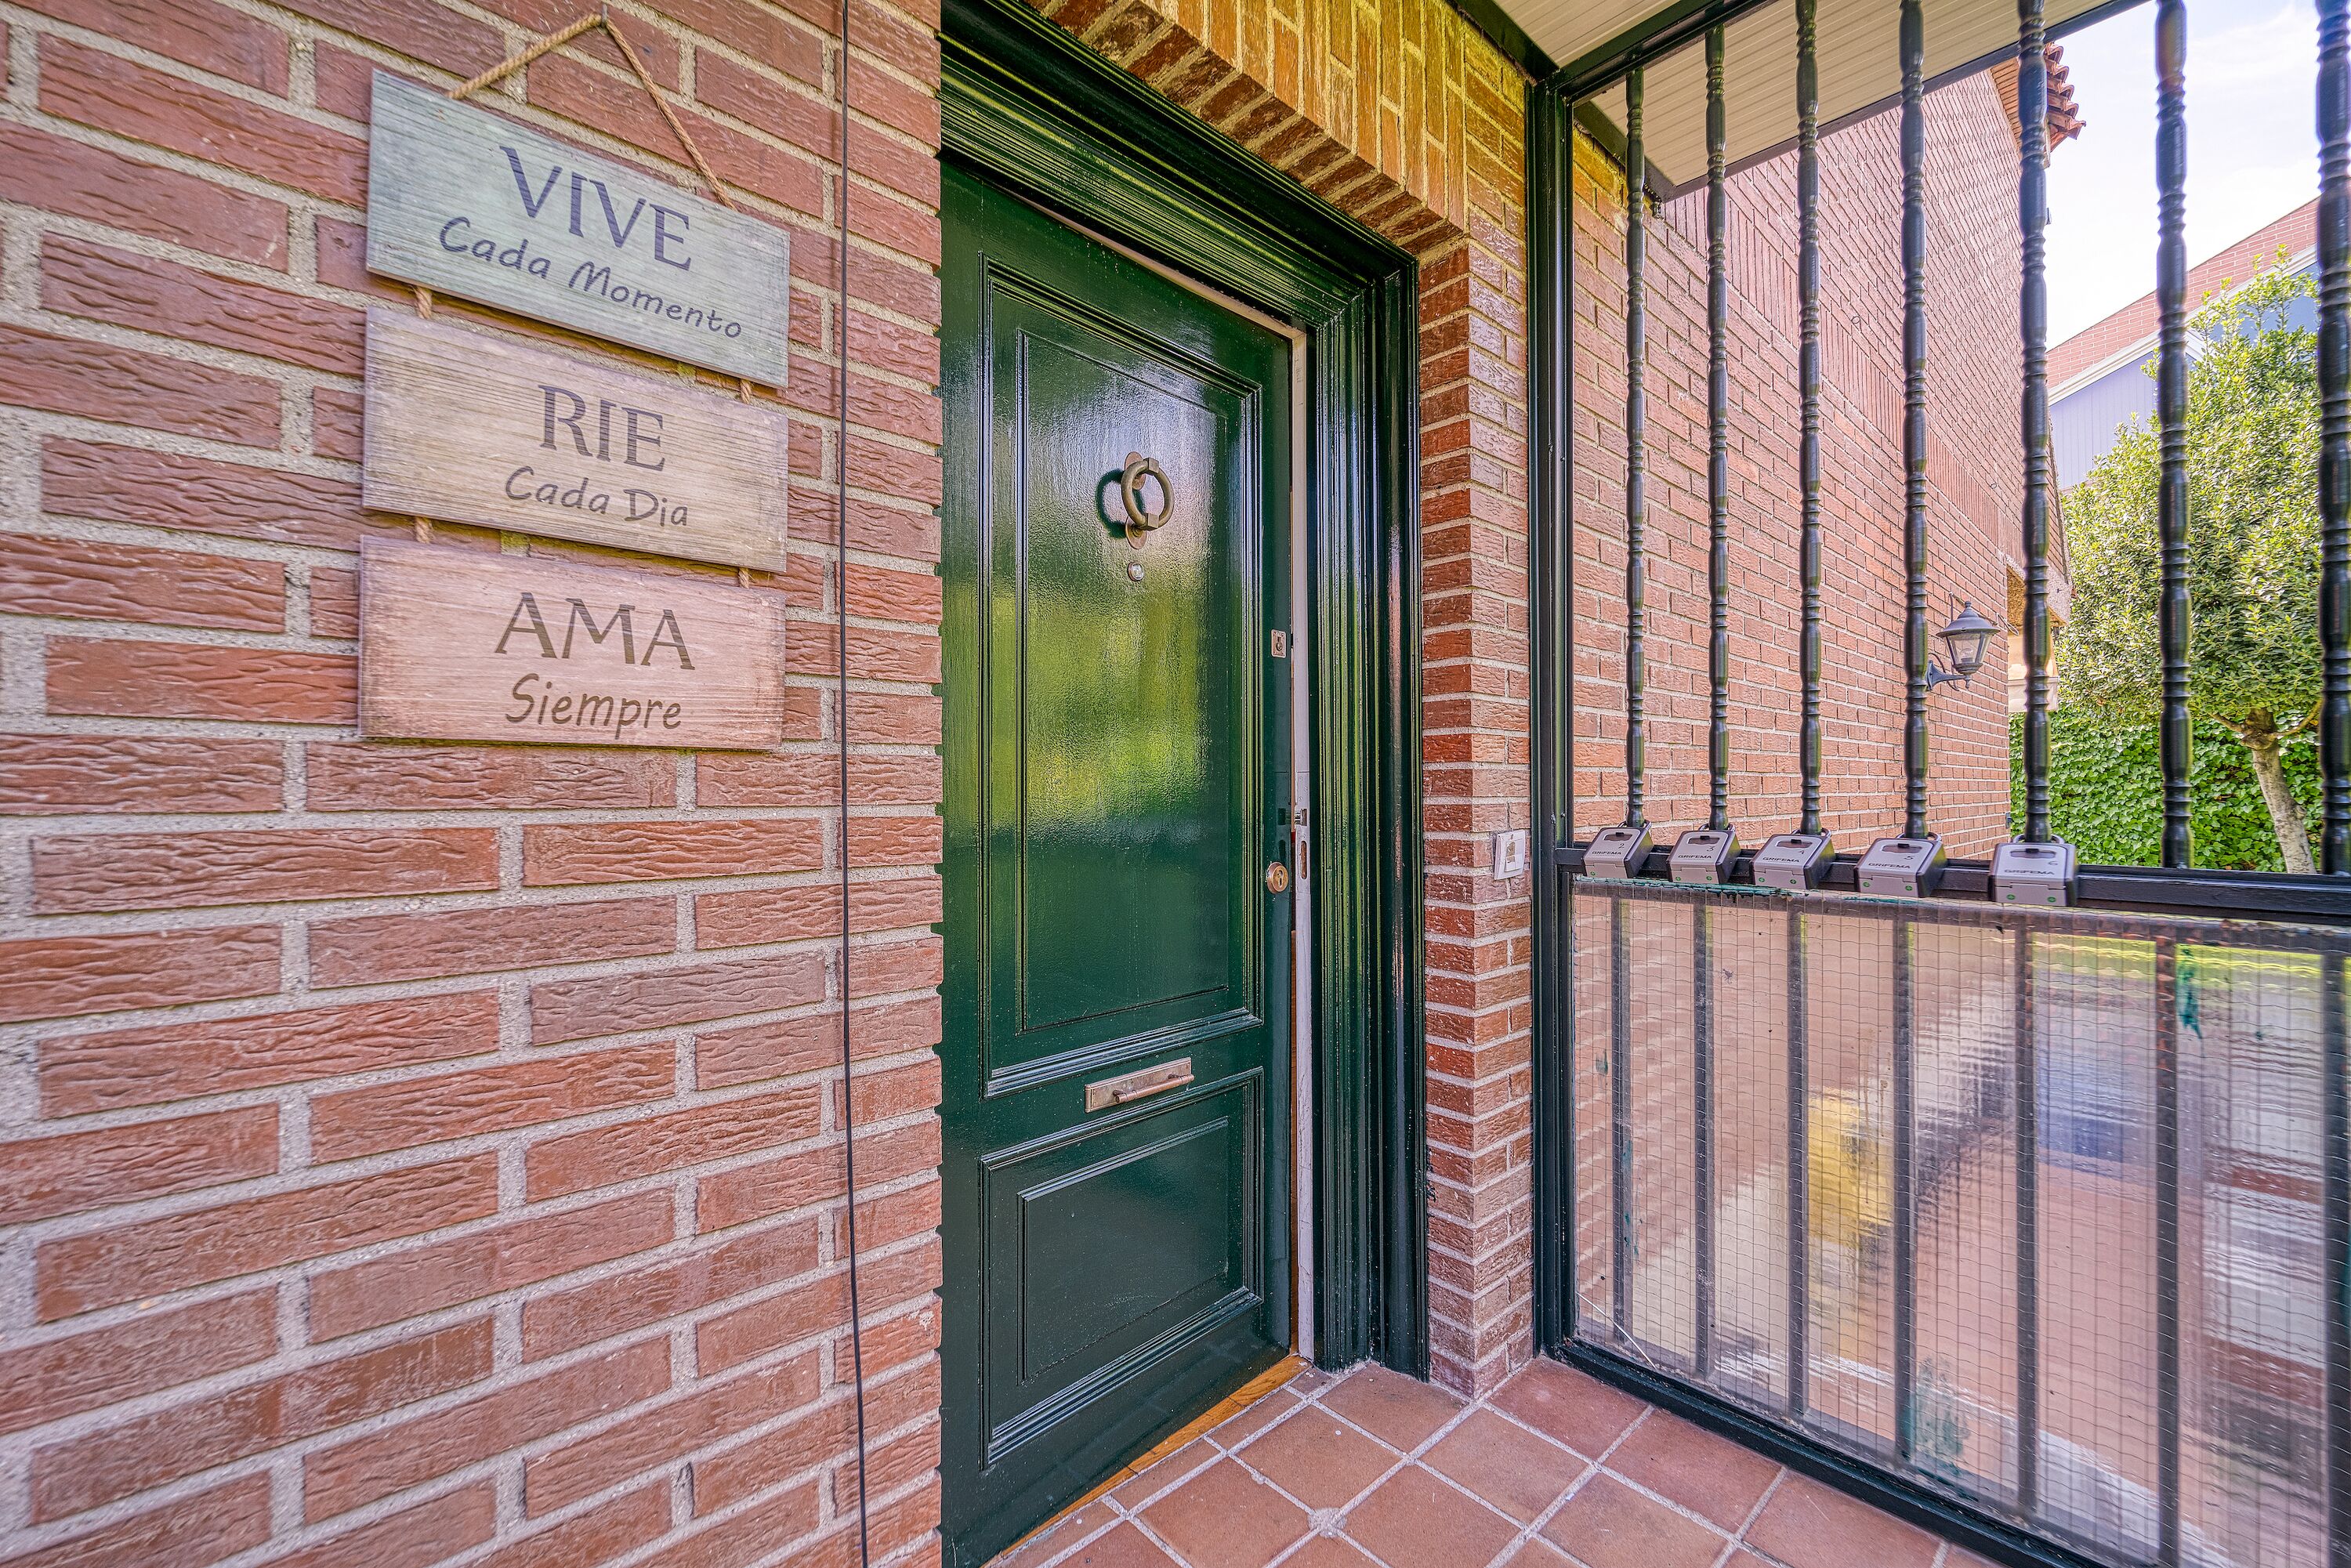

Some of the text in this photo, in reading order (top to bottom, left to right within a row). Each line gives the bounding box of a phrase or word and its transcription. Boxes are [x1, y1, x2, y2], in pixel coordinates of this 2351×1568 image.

[499, 145, 692, 272] VIVE
[439, 216, 742, 339] Cada Momento
[538, 384, 666, 472] RIE
[505, 465, 688, 527] Cada Dia
[494, 591, 696, 671] AMA
[505, 672, 683, 741] Siempre
